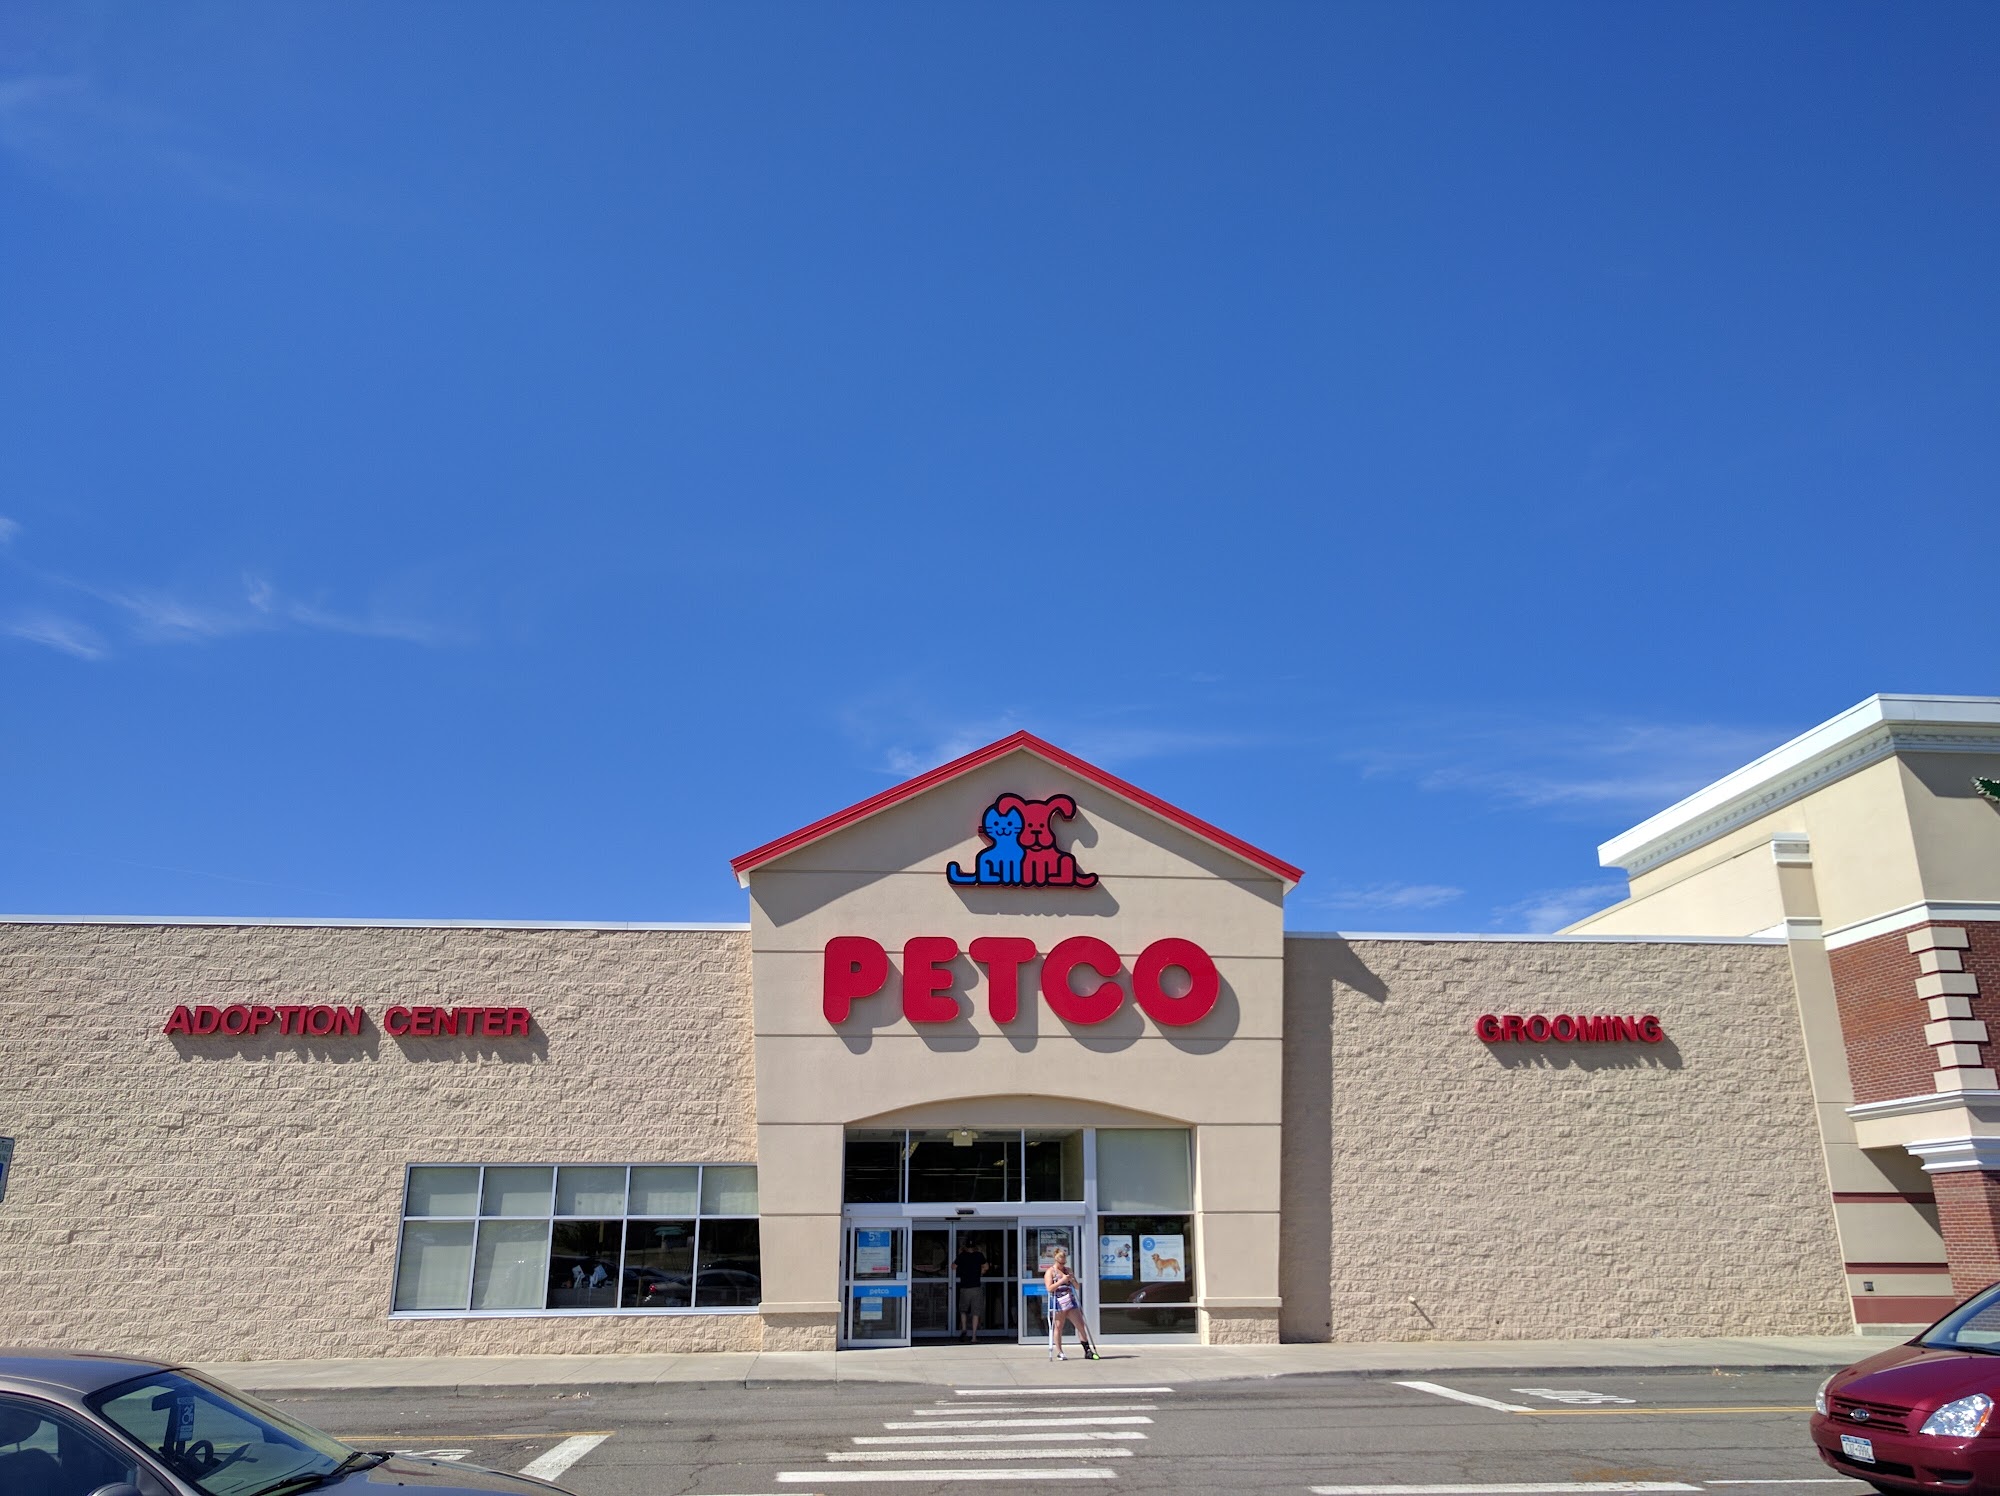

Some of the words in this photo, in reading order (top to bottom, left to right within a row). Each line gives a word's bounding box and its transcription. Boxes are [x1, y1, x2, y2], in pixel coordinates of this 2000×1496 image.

[823, 936, 1220, 1026] PETCO
[163, 1005, 363, 1036] ADOPTION
[384, 1006, 531, 1036] CENTER
[1474, 1014, 1664, 1043] GROOMING
[869, 1287, 890, 1296] petco
